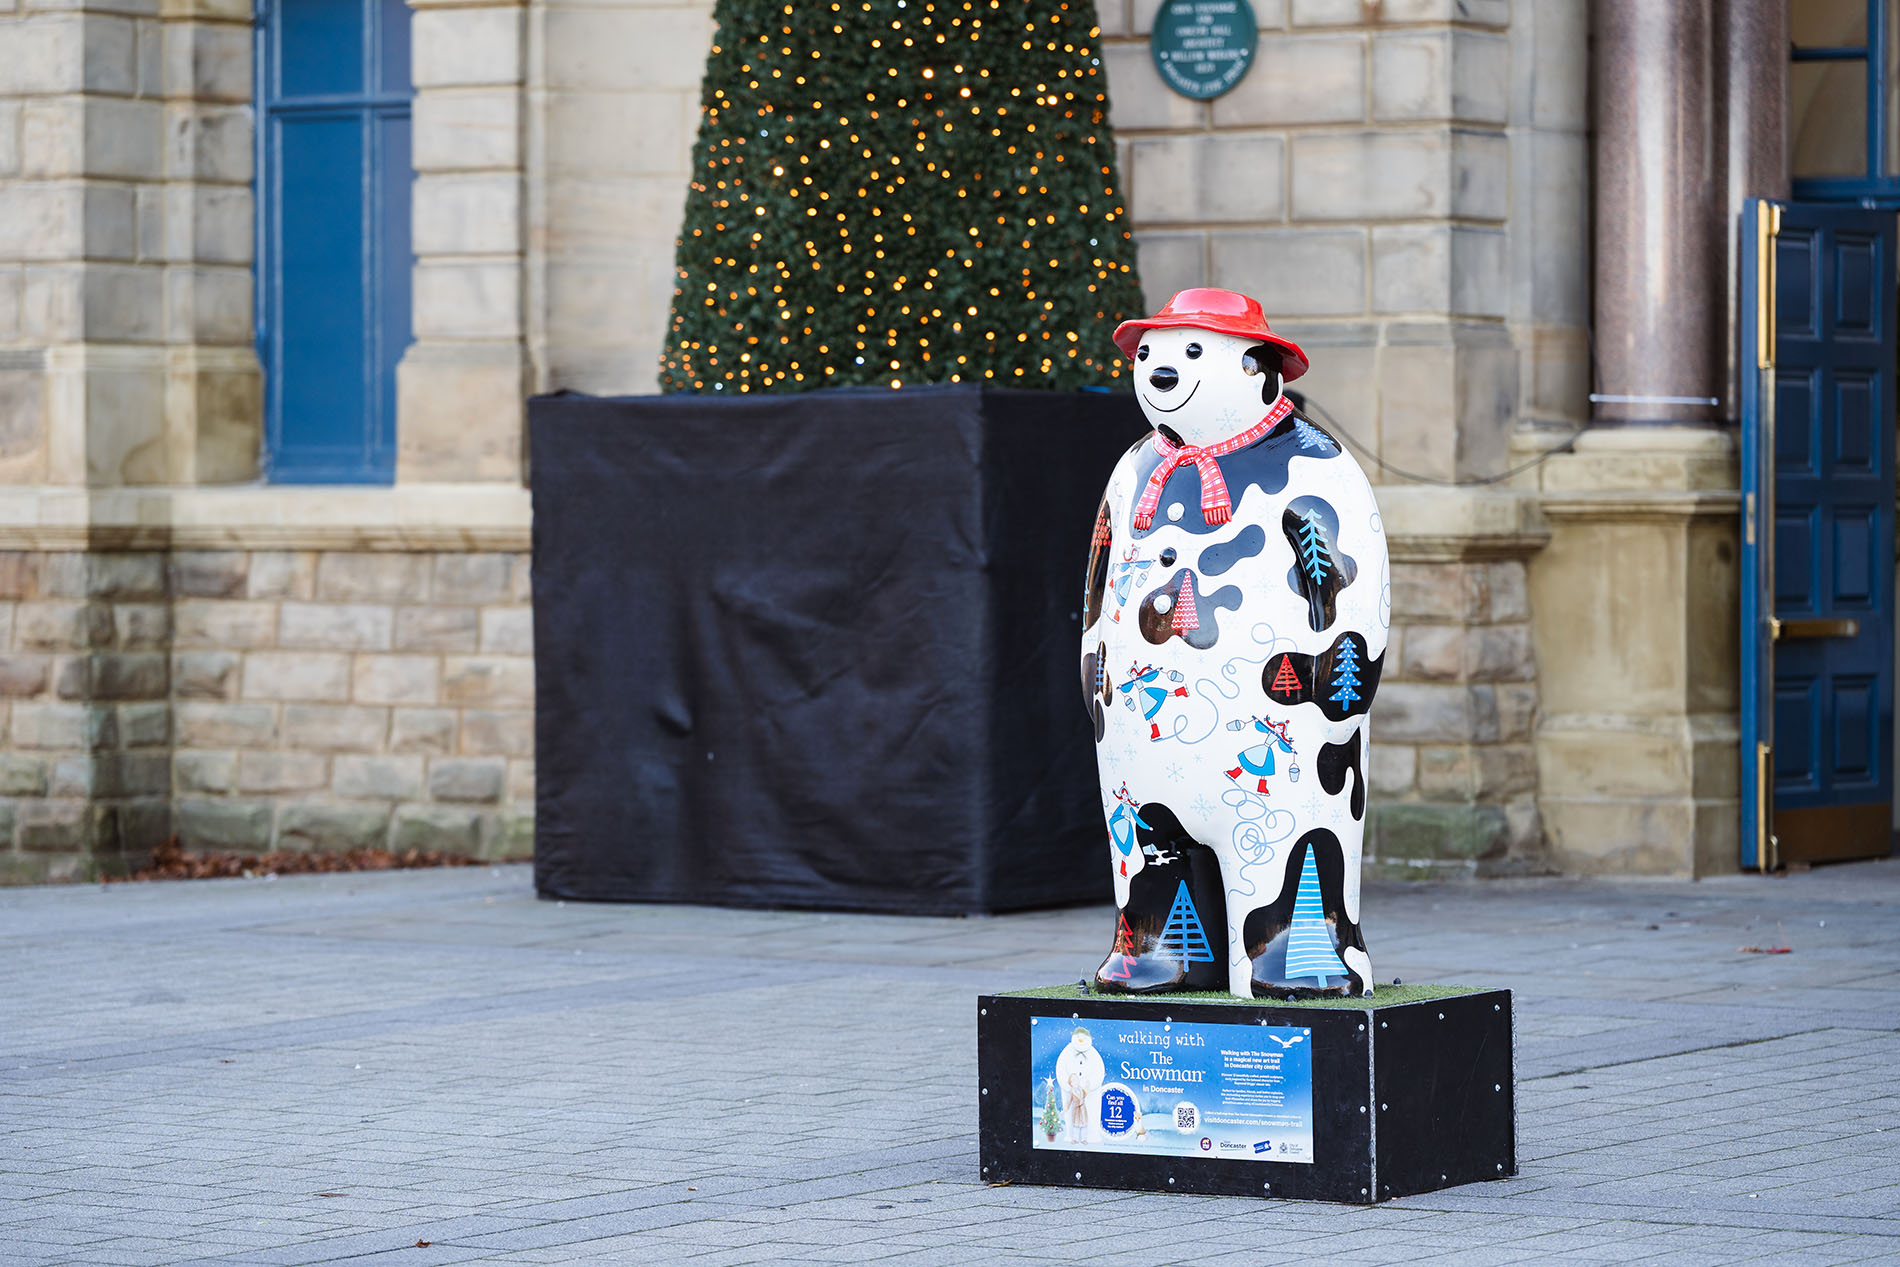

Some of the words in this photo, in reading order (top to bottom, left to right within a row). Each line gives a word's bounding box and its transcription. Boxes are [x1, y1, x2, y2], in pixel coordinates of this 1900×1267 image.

[1118, 1031, 1170, 1049] walking
[1176, 1033, 1205, 1046] with
[1149, 1051, 1173, 1064] The
[1150, 1085, 1184, 1094] Doncaster
[1109, 1106, 1122, 1118] 12
